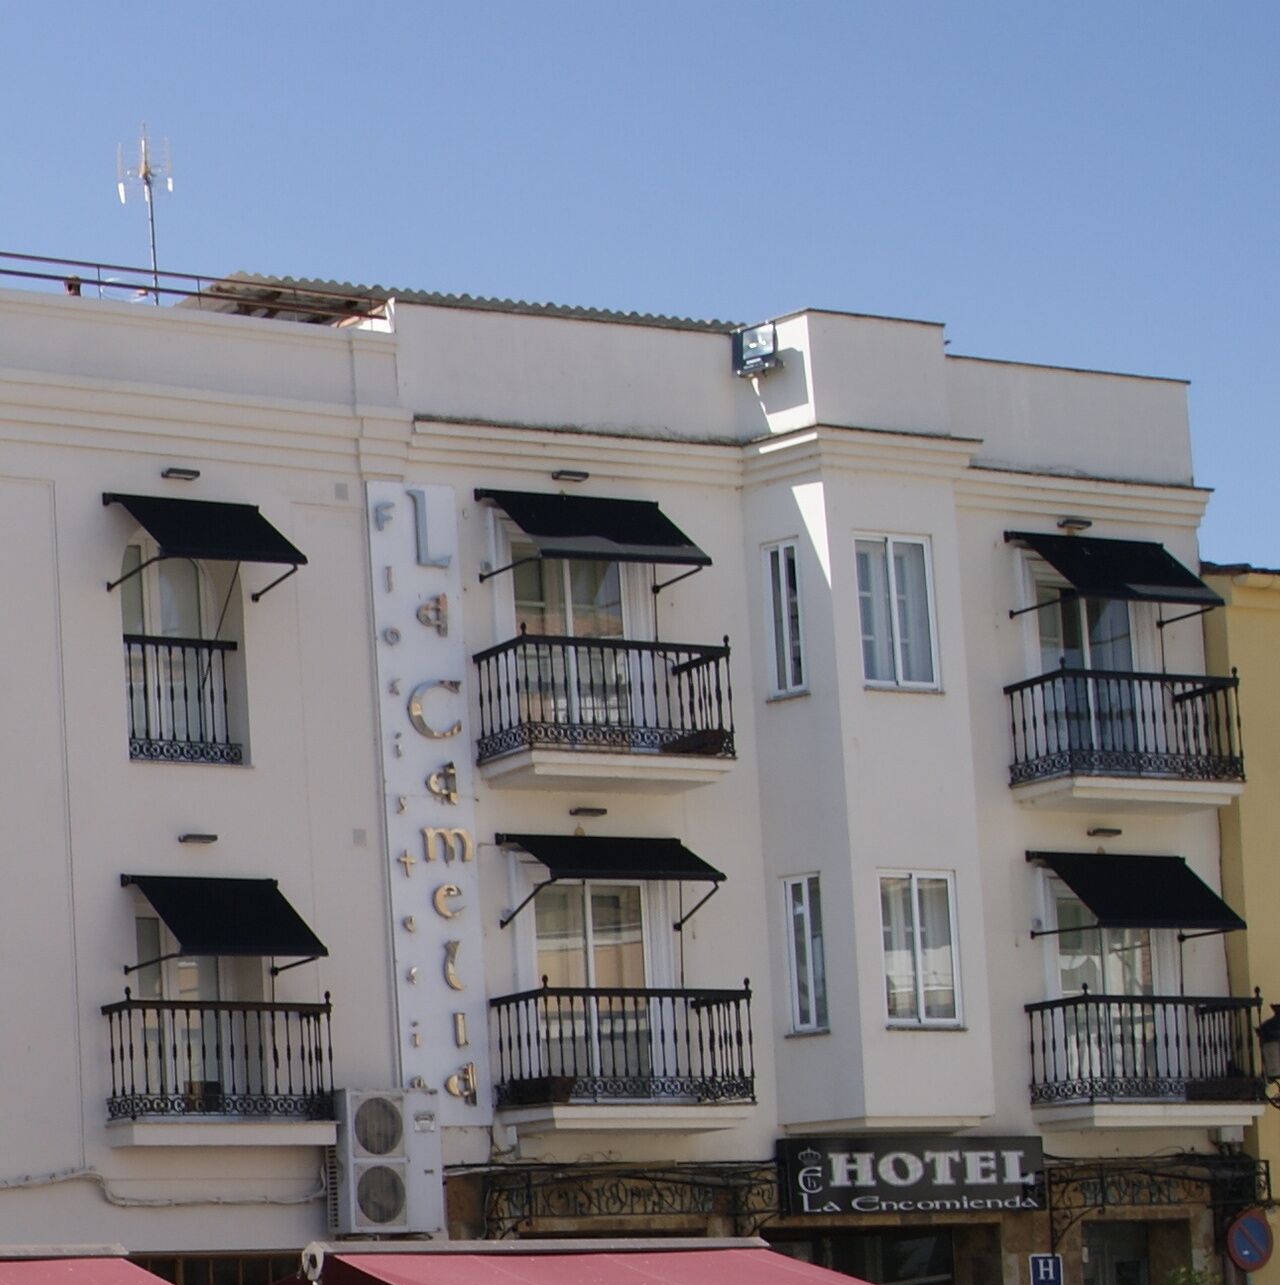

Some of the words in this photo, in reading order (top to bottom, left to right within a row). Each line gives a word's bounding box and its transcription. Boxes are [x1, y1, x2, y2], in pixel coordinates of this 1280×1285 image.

[827, 1149, 1036, 1187] HOTEL
[799, 1191, 842, 1213] La
[851, 1194, 1040, 1213] Encomienda
[1037, 1258, 1056, 1281] H
